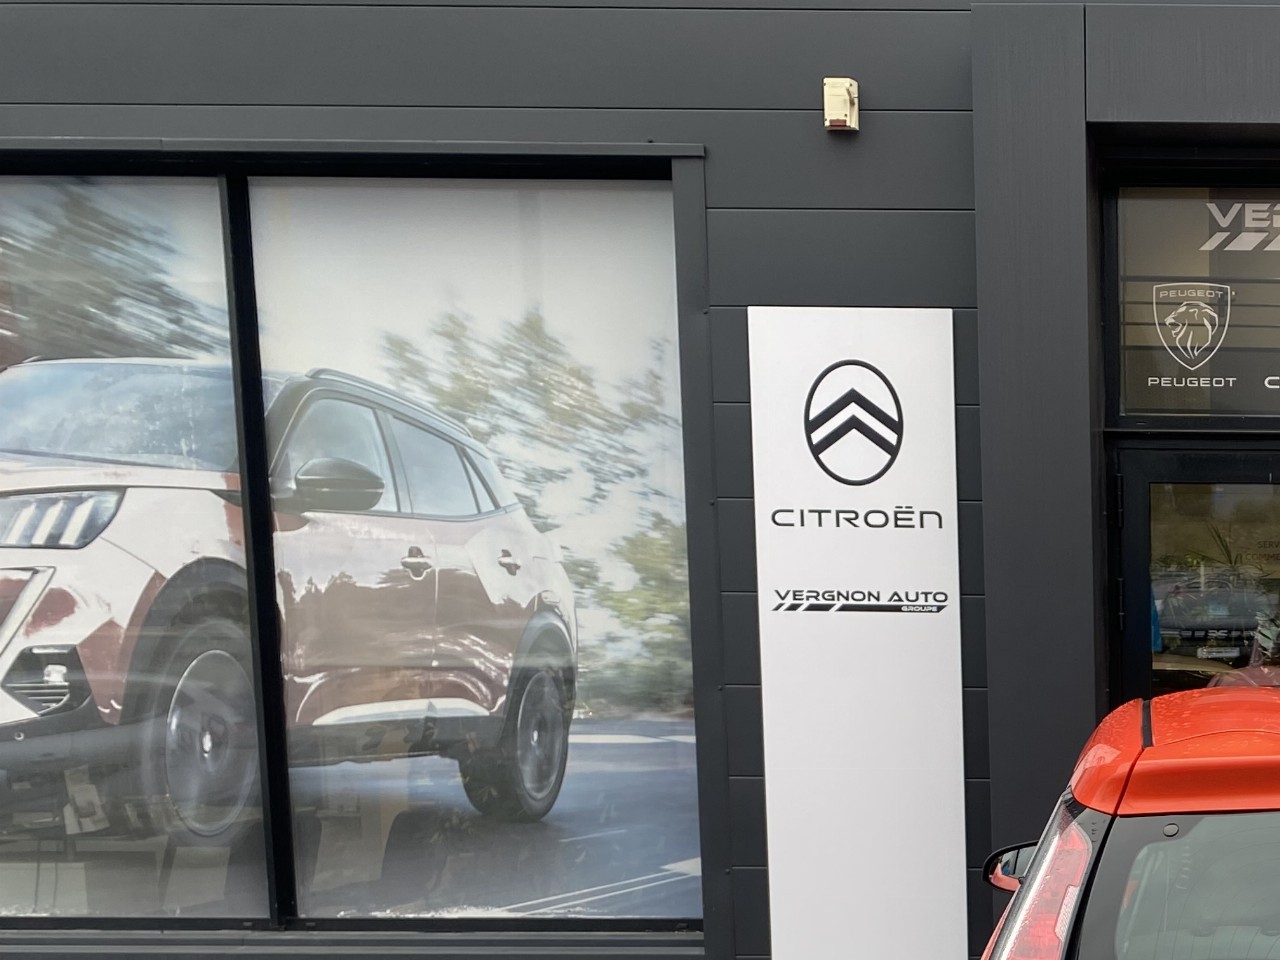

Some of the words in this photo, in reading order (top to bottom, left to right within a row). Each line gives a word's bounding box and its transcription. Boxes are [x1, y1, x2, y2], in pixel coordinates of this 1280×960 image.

[1159, 290, 1223, 298] PEUGEOT
[1148, 377, 1237, 387] PEUGEOT
[771, 506, 943, 529] CITROËN
[774, 589, 880, 602] VERGNON
[887, 591, 948, 603] AUTO
